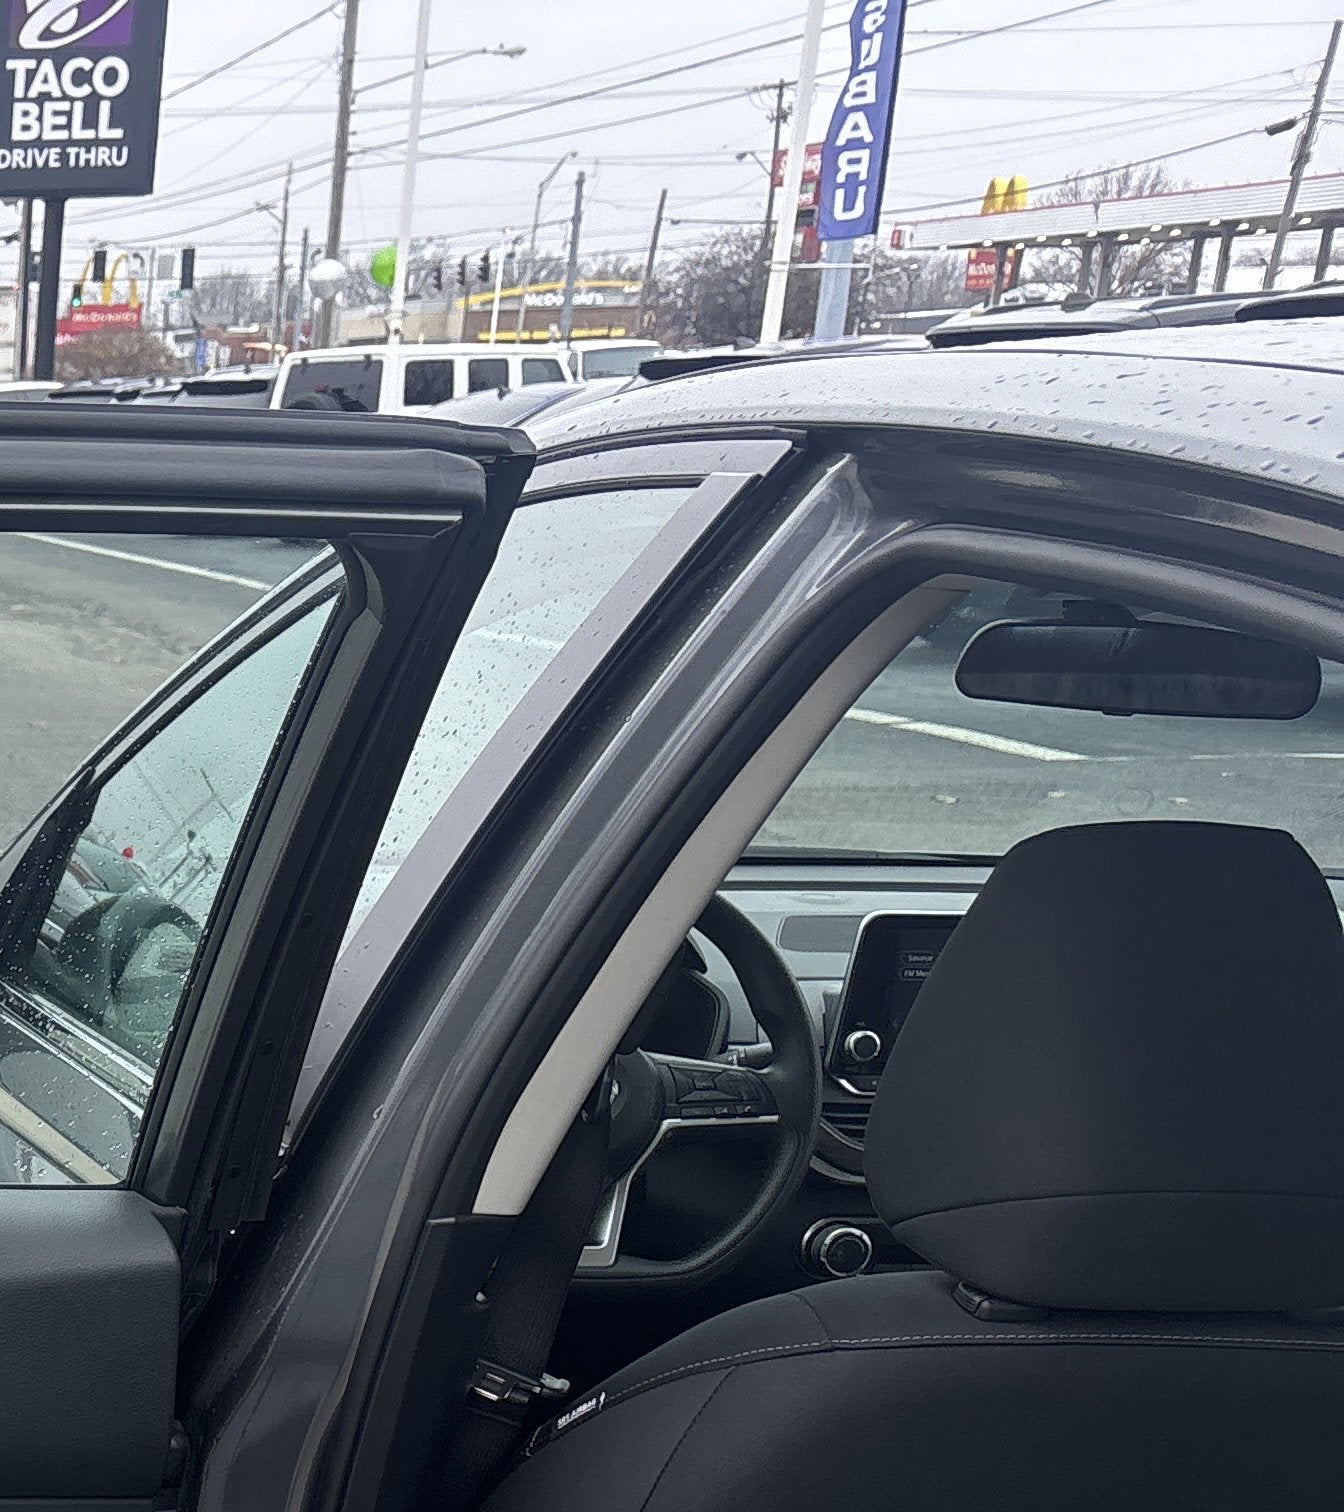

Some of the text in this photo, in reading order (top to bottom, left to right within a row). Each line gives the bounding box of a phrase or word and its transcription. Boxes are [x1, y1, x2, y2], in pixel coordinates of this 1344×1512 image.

[5, 56, 130, 98] TACO
[11, 100, 124, 141] BELL
[66, 146, 128, 167] THRU
